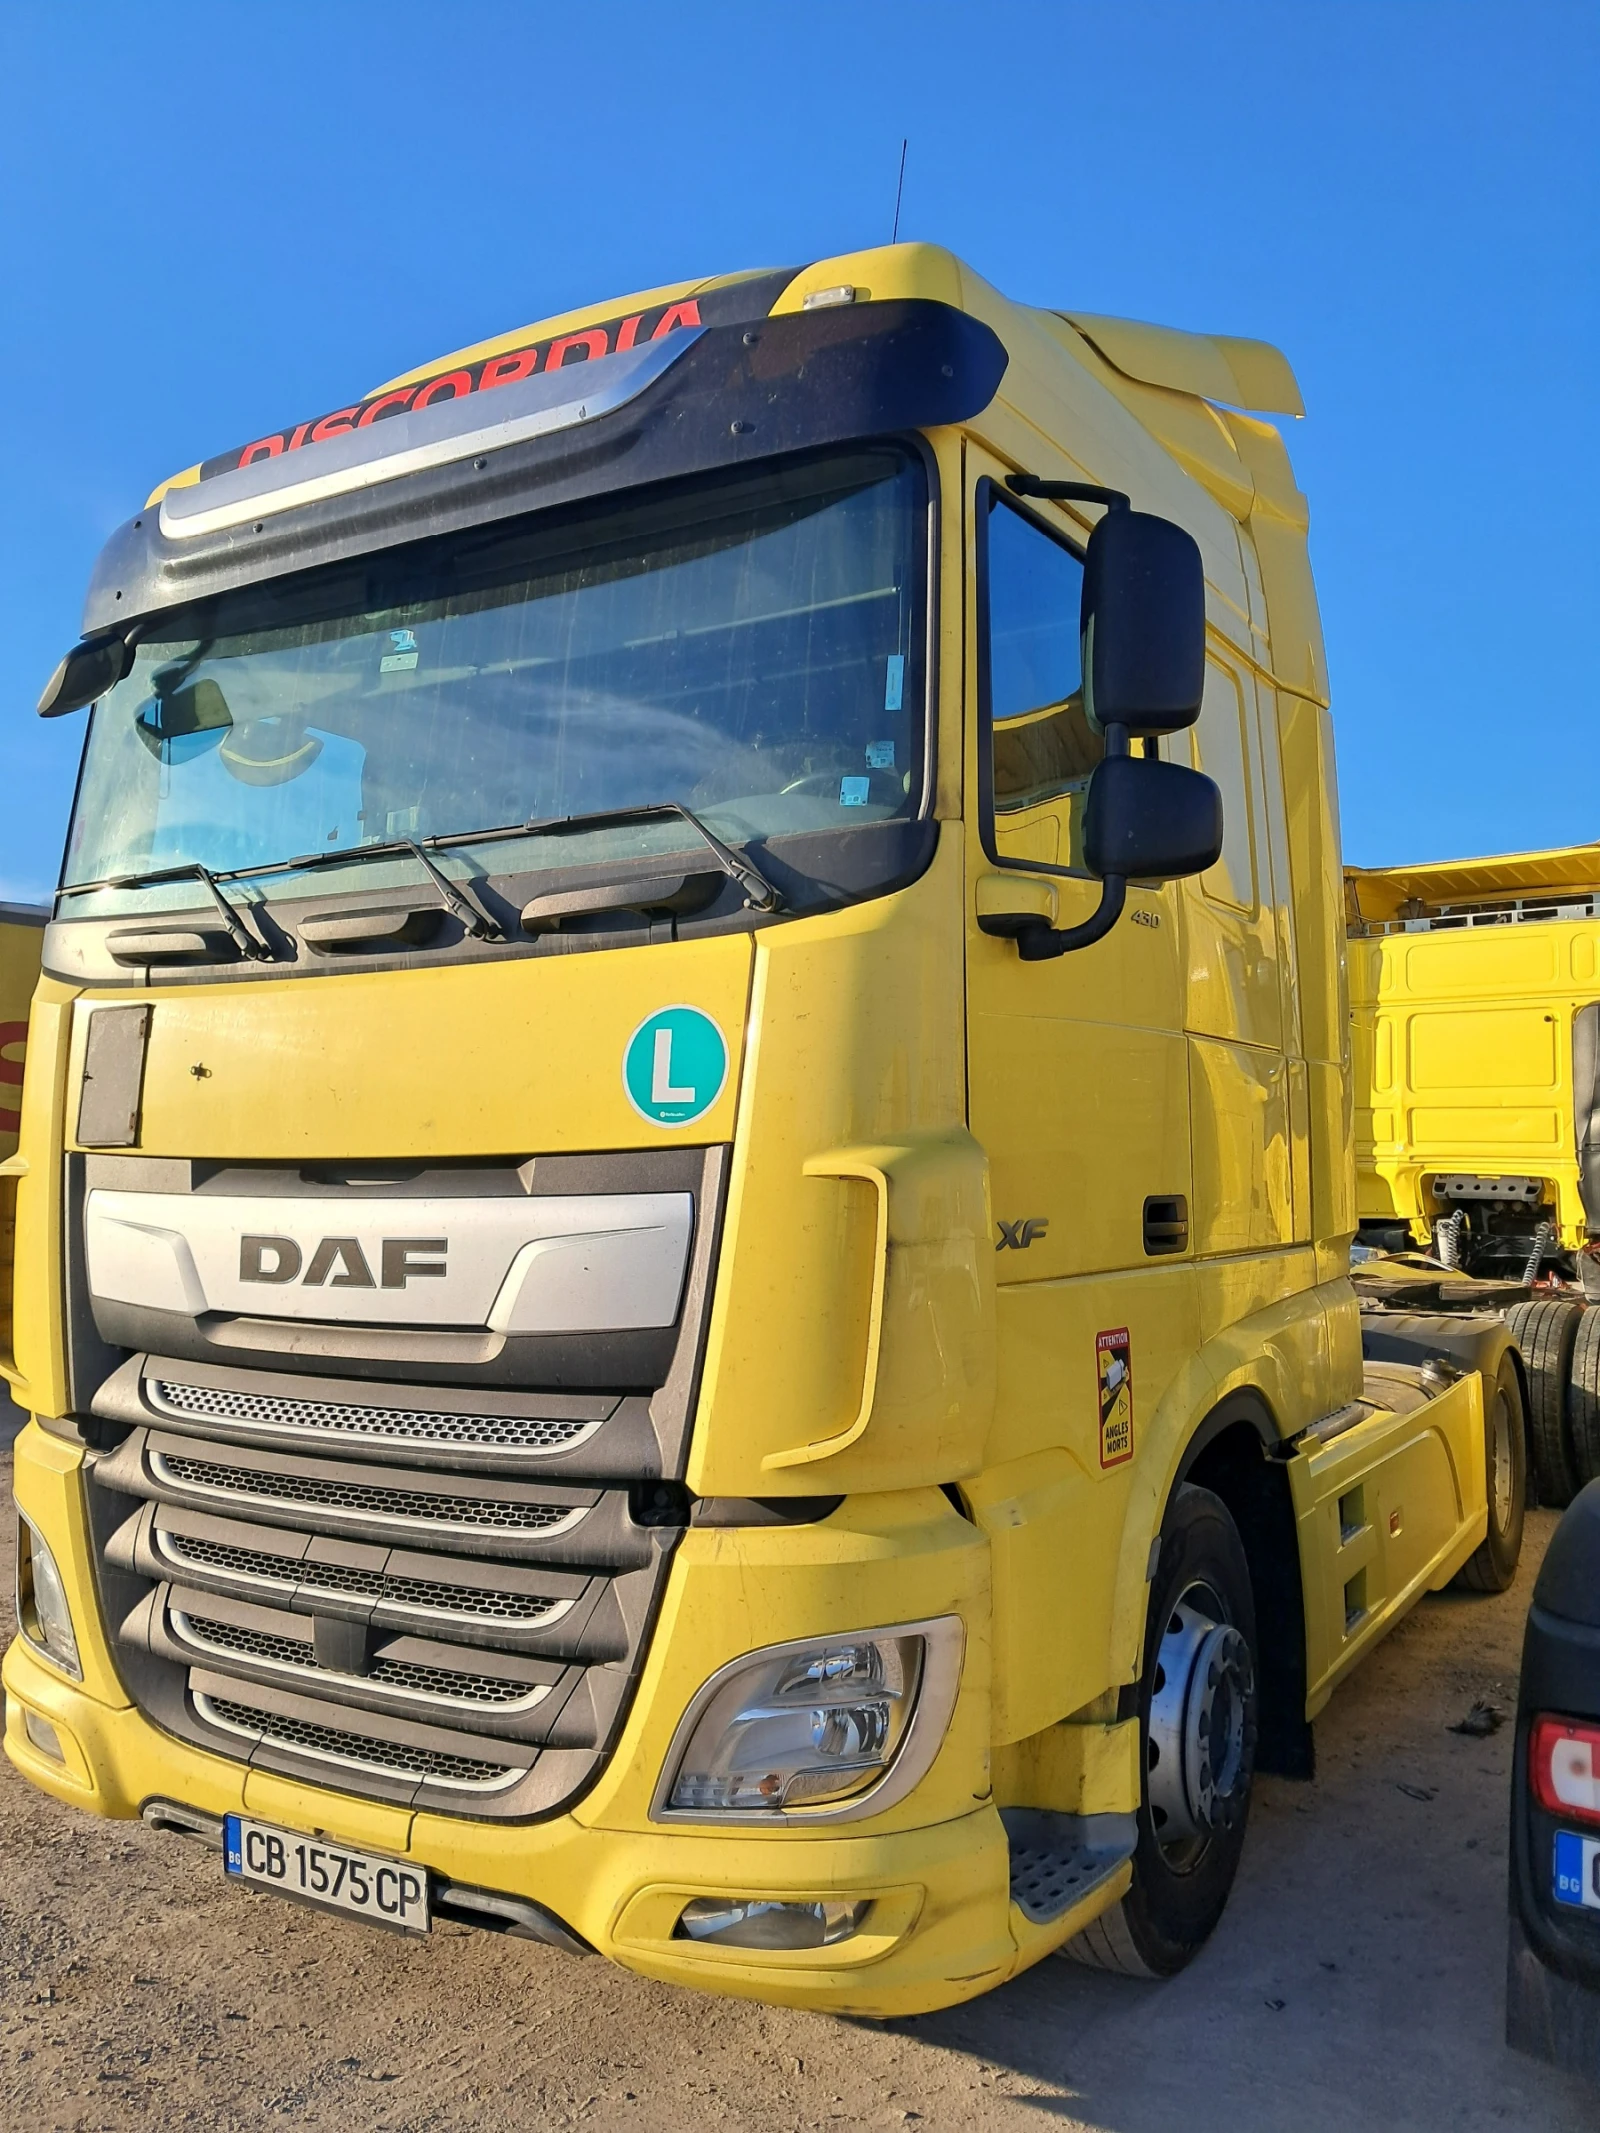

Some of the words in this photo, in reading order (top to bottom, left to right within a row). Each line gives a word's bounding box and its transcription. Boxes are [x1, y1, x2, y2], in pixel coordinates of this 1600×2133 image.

[651, 1028, 696, 1104] L
[996, 1217, 1049, 1252] XF
[239, 1233, 448, 1289] DAF
[1097, 1331, 1129, 1348] ATTENTION
[1105, 1421, 1129, 1441] ANGLES
[1106, 1436, 1128, 1455] MORTS
[228, 1850, 241, 1866] BG
[1558, 1874, 1580, 1894] BG
